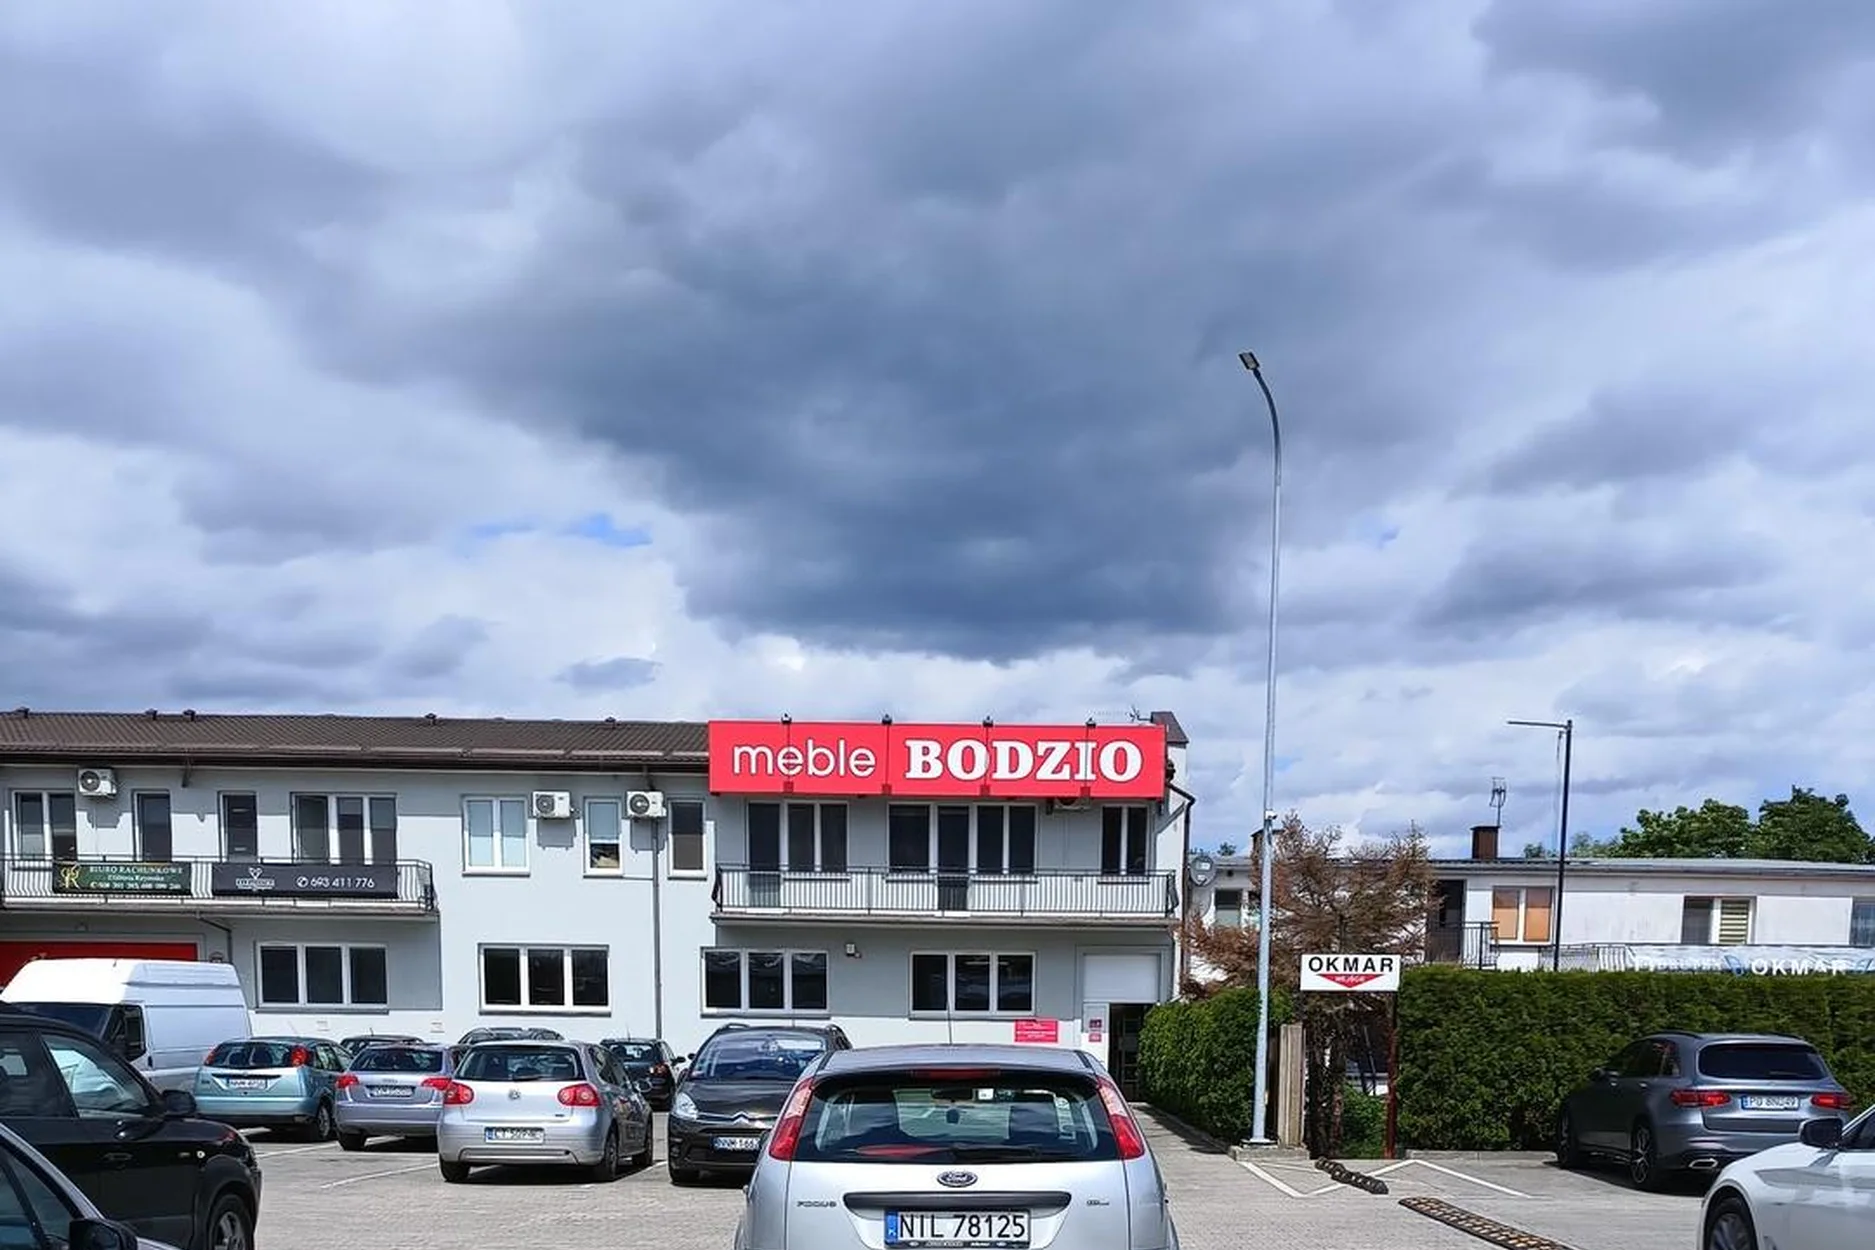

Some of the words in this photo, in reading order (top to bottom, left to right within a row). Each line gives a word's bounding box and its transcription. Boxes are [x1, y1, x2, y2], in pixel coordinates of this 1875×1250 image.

[733, 739, 876, 778] meble
[904, 739, 1143, 783] BODZIO
[310, 877, 331, 888] 693
[332, 877, 352, 888] 411
[354, 877, 375, 888] 776
[1308, 956, 1394, 973] OKMAR
[1751, 957, 1846, 976] OKMAR
[900, 1214, 945, 1238] NIL
[952, 1214, 1026, 1238] 78125
